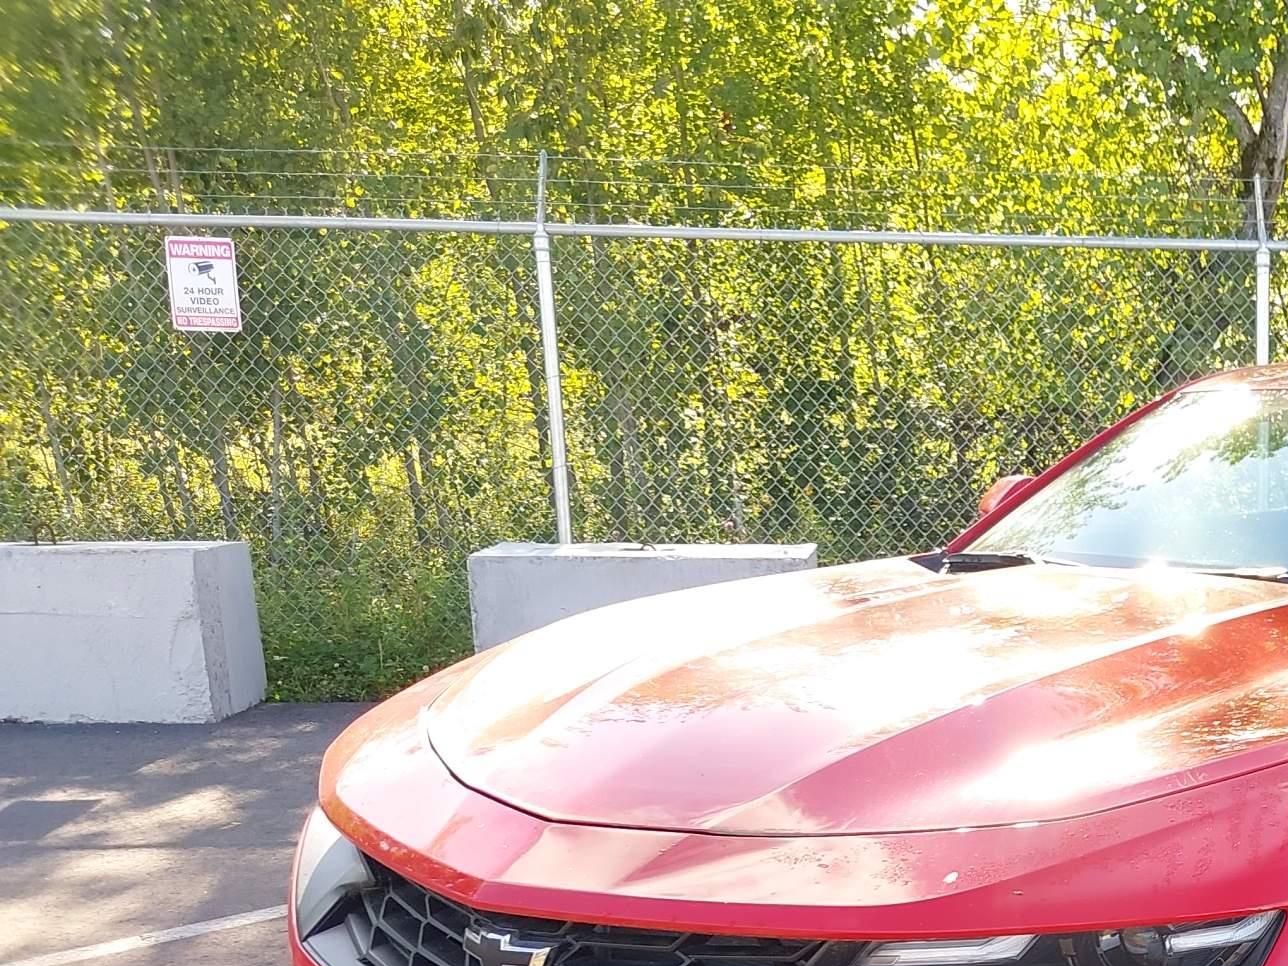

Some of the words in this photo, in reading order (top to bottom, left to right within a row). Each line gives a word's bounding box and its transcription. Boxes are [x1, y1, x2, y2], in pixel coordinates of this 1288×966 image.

[169, 243, 231, 257] WARNING
[183, 287, 195, 295] 24
[197, 287, 224, 296] HOUR
[190, 297, 220, 305] VIDEO
[176, 306, 236, 315] SURVEILLANCE
[177, 317, 188, 325] NO
[189, 317, 237, 327] TRESPASSING
